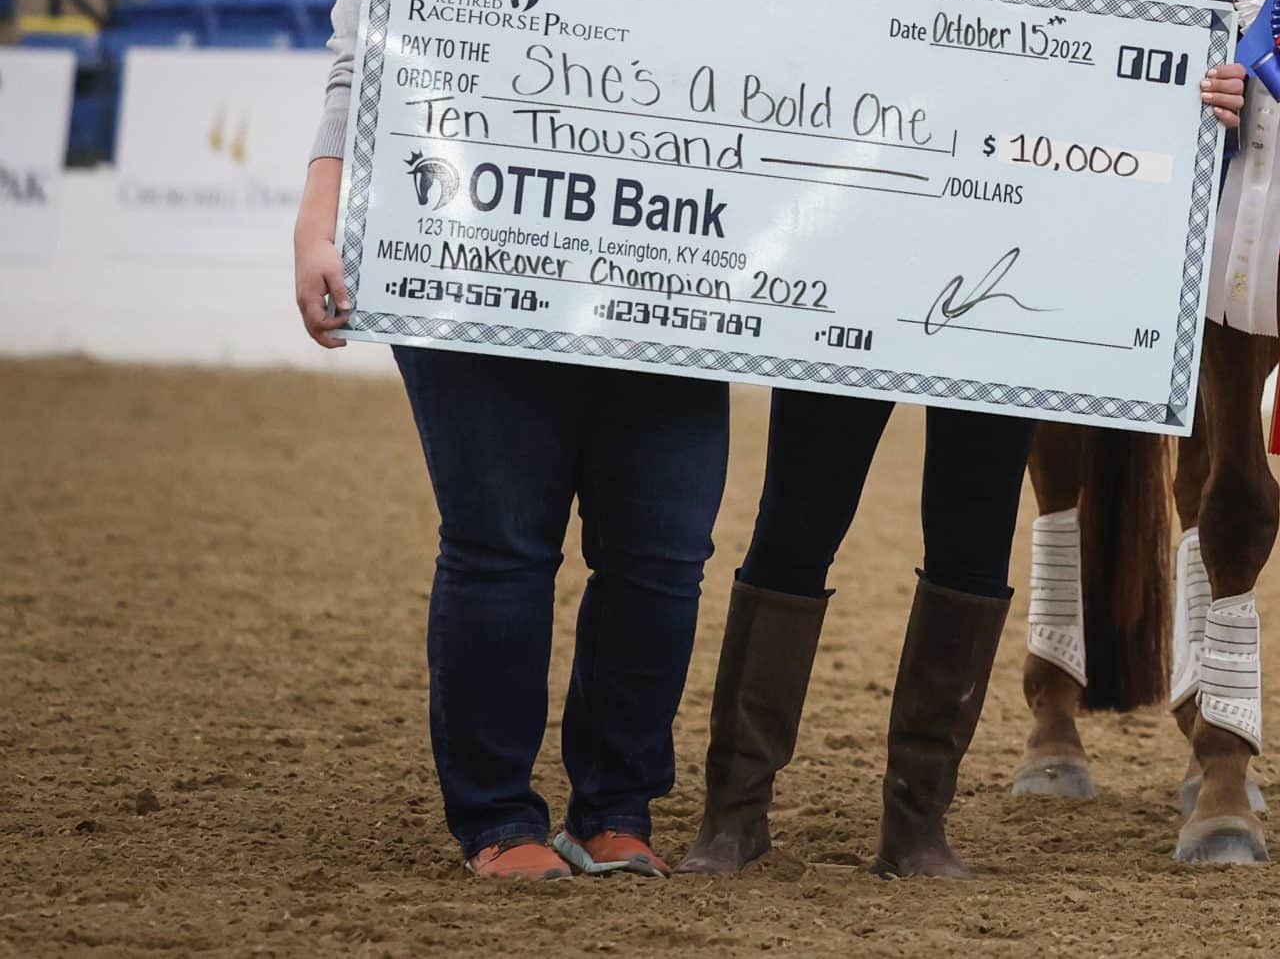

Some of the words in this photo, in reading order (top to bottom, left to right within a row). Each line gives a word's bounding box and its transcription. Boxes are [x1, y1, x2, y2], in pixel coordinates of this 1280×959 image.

[401, 35, 434, 58] PAY
[435, 38, 456, 59] TO
[459, 40, 491, 63] THE
[543, 13, 630, 42] PROJECT
[889, 17, 927, 42] Date
[932, 11, 1011, 49] October
[1049, 38, 1093, 62] 2022
[397, 67, 455, 91] ORDER
[457, 72, 480, 93] OF
[1116, 45, 1189, 86] 001
[512, 44, 661, 107] She's
[742, 74, 832, 129] Bold
[853, 92, 932, 145] One
[405, 96, 489, 139] Ten
[513, 110, 743, 170] Thousand
[982, 135, 996, 156] $
[1009, 134, 1140, 178] 10,000
[469, 162, 596, 222] OTTB
[611, 177, 728, 239] Bank
[942, 176, 1023, 205] /DOLLARS
[416, 217, 443, 237] 123
[448, 220, 550, 250] Thoroughbred
[553, 231, 593, 255] Lane,
[598, 236, 672, 264] Lexington,
[676, 244, 698, 265] KY
[702, 247, 748, 270] 40509
[376, 239, 432, 265] MEMO
[439, 242, 568, 281] Makeover
[589, 256, 731, 303] Champion
[751, 270, 829, 309] 2022
[1133, 328, 1160, 350] MP
